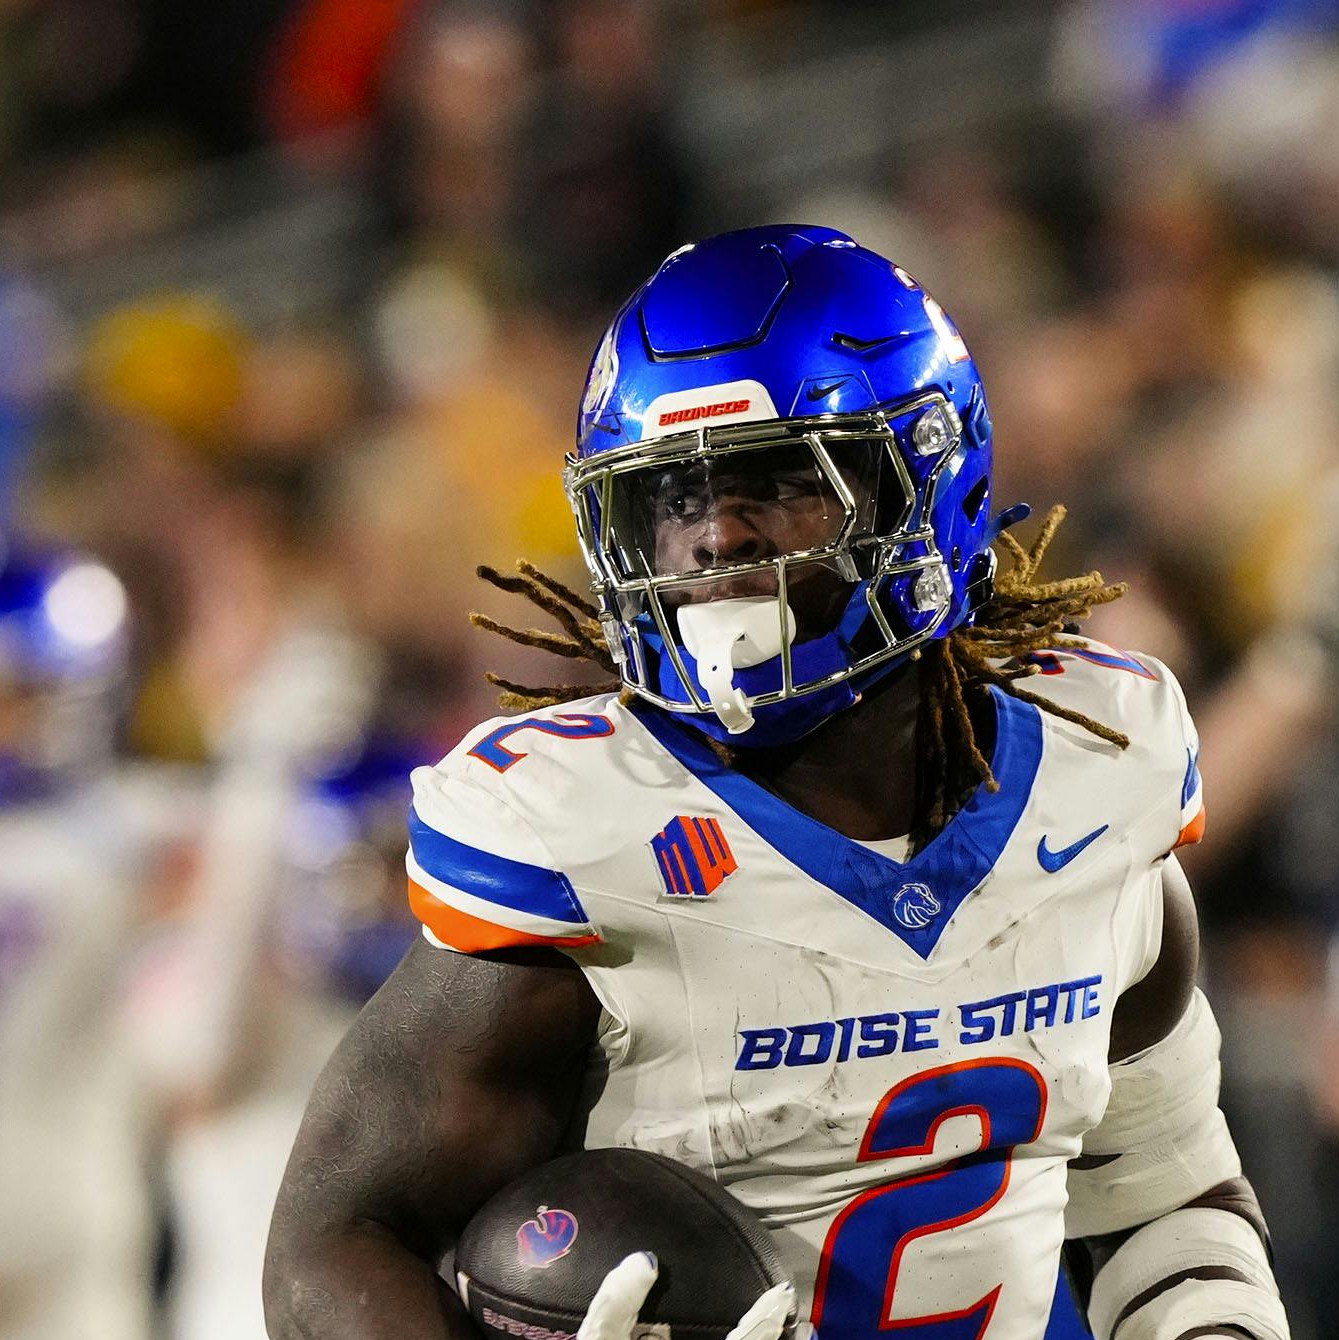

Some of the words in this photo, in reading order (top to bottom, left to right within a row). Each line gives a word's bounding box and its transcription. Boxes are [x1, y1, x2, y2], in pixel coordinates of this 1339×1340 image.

[658, 400, 750, 426] BRONCOS
[466, 714, 615, 774] 2
[735, 1009, 940, 1071] BOISE
[956, 974, 1102, 1045] STATE
